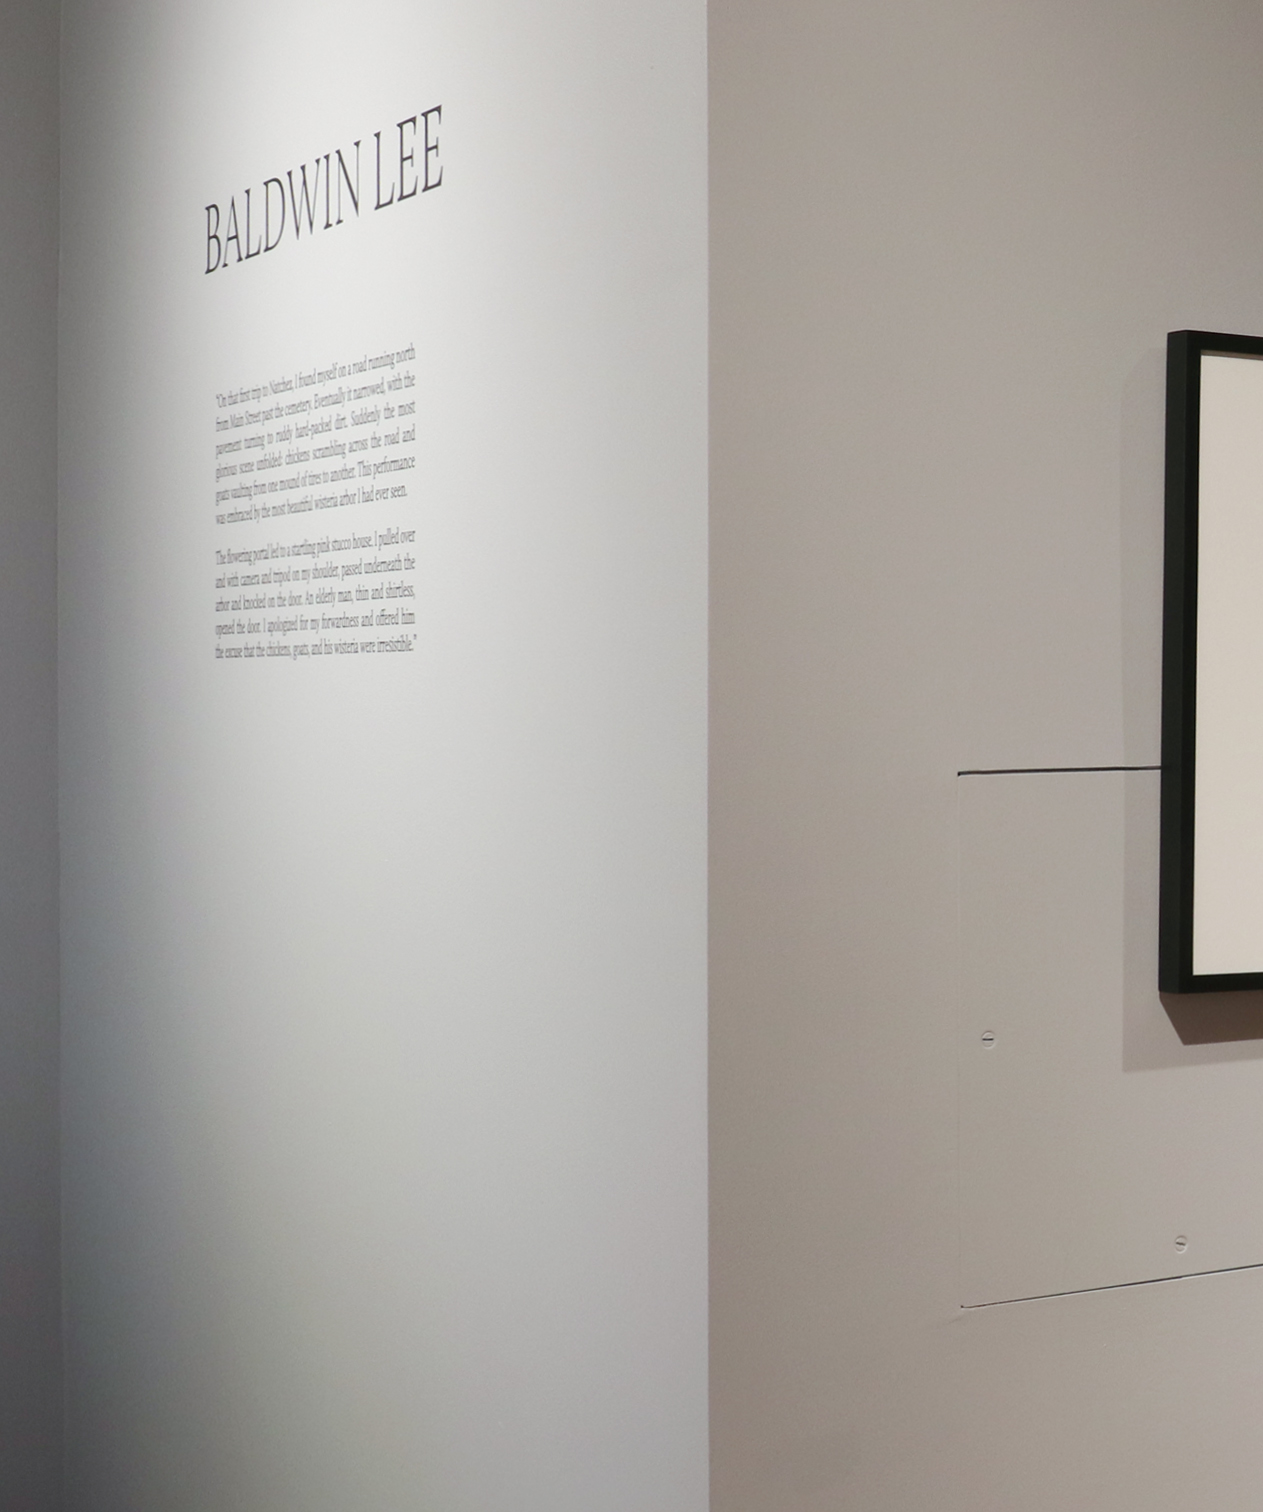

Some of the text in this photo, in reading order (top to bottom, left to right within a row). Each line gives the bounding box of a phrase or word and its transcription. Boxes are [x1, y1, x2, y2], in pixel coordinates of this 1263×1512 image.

[205, 104, 443, 275] BALDWIN LEE
[228, 391, 238, 406] that
[240, 388, 251, 403] first
[251, 385, 262, 403] trip
[262, 386, 270, 397] to
[299, 368, 317, 388] found
[318, 362, 339, 386] myself
[338, 366, 347, 378] on
[352, 355, 368, 374] road
[368, 351, 395, 370] running
[396, 342, 416, 363] north
[216, 417, 229, 432] from
[230, 414, 245, 428] Main
[245, 411, 262, 425] Street
[262, 408, 274, 426] past
[275, 402, 285, 418] the
[314, 387, 346, 409] Eventually
[347, 387, 353, 401] it
[388, 373, 403, 391] with
[404, 371, 416, 388] the
[216, 440, 242, 459] pavement
[244, 435, 266, 450] turning
[267, 433, 274, 444] to
[276, 425, 294, 444] ruddy
[295, 415, 333, 440] hard-packed
[351, 405, 382, 426] Suddenly
[384, 402, 395, 419] the
[398, 401, 416, 417] most
[216, 463, 238, 483] glorious
[239, 462, 255, 474] scene
[285, 447, 311, 465] chickens
[312, 440, 347, 460] scrambling
[349, 439, 369, 453] across
[371, 431, 383, 448] the
[384, 427, 400, 446] road
[402, 423, 416, 442] and
[216, 490, 231, 506] goats
[231, 483, 253, 501] vaulting
[253, 480, 267, 496] from
[268, 481, 279, 493] one
[279, 472, 301, 491] mound
[301, 470, 309, 487] of
[308, 471, 322, 486] tires
[323, 472, 330, 483] to
[357, 460, 373, 477] This
[373, 456, 416, 480] performance
[216, 514, 227, 524] was
[227, 505, 253, 523] embraced
[254, 504, 261, 523] by
[262, 503, 271, 518] the
[272, 504, 287, 517] most
[287, 495, 314, 514] beautiful
[315, 493, 339, 509] wisteria
[339, 489, 358, 506] arbor
[362, 485, 374, 503] had
[375, 488, 390, 501] ever
[216, 550, 227, 565] The
[227, 548, 253, 566] flowering
[253, 544, 270, 565] portal
[271, 543, 280, 559] led
[280, 547, 287, 557] to
[292, 539, 316, 559] startling
[317, 536, 331, 558] pink
[332, 539, 352, 551] stucco
[379, 527, 400, 551] pulled
[401, 530, 416, 543] over
[216, 573, 226, 588] and
[227, 572, 240, 587] with
[241, 574, 261, 586] camera
[261, 568, 273, 584] and
[273, 566, 291, 587] tripod
[292, 570, 301, 581] on
[301, 569, 311, 584] my
[341, 558, 363, 581] passed
[364, 554, 402, 574] underneath
[404, 553, 416, 570] the
[216, 597, 231, 612] arbor
[231, 595, 242, 611] and
[243, 593, 267, 610] knocked
[268, 597, 276, 608] on
[277, 592, 287, 607] the
[305, 591, 314, 605] An
[315, 587, 337, 607] elderly
[356, 584, 370, 601] thin
[371, 582, 384, 600] and
[216, 619, 236, 639] opened
[236, 619, 246, 634] the
[267, 615, 299, 636] apologized
[300, 614, 309, 630] for
[310, 619, 320, 634] my
[322, 611, 359, 629] forwardness
[361, 609, 374, 627] and
[376, 608, 400, 626] offered
[401, 607, 416, 625] him
[216, 644, 225, 659] the
[225, 648, 243, 658] excuse
[244, 642, 256, 658] that
[256, 642, 266, 657] the
[311, 638, 324, 655] and
[324, 638, 334, 655] his
[334, 638, 359, 654] wisteria
[360, 642, 376, 653] were
